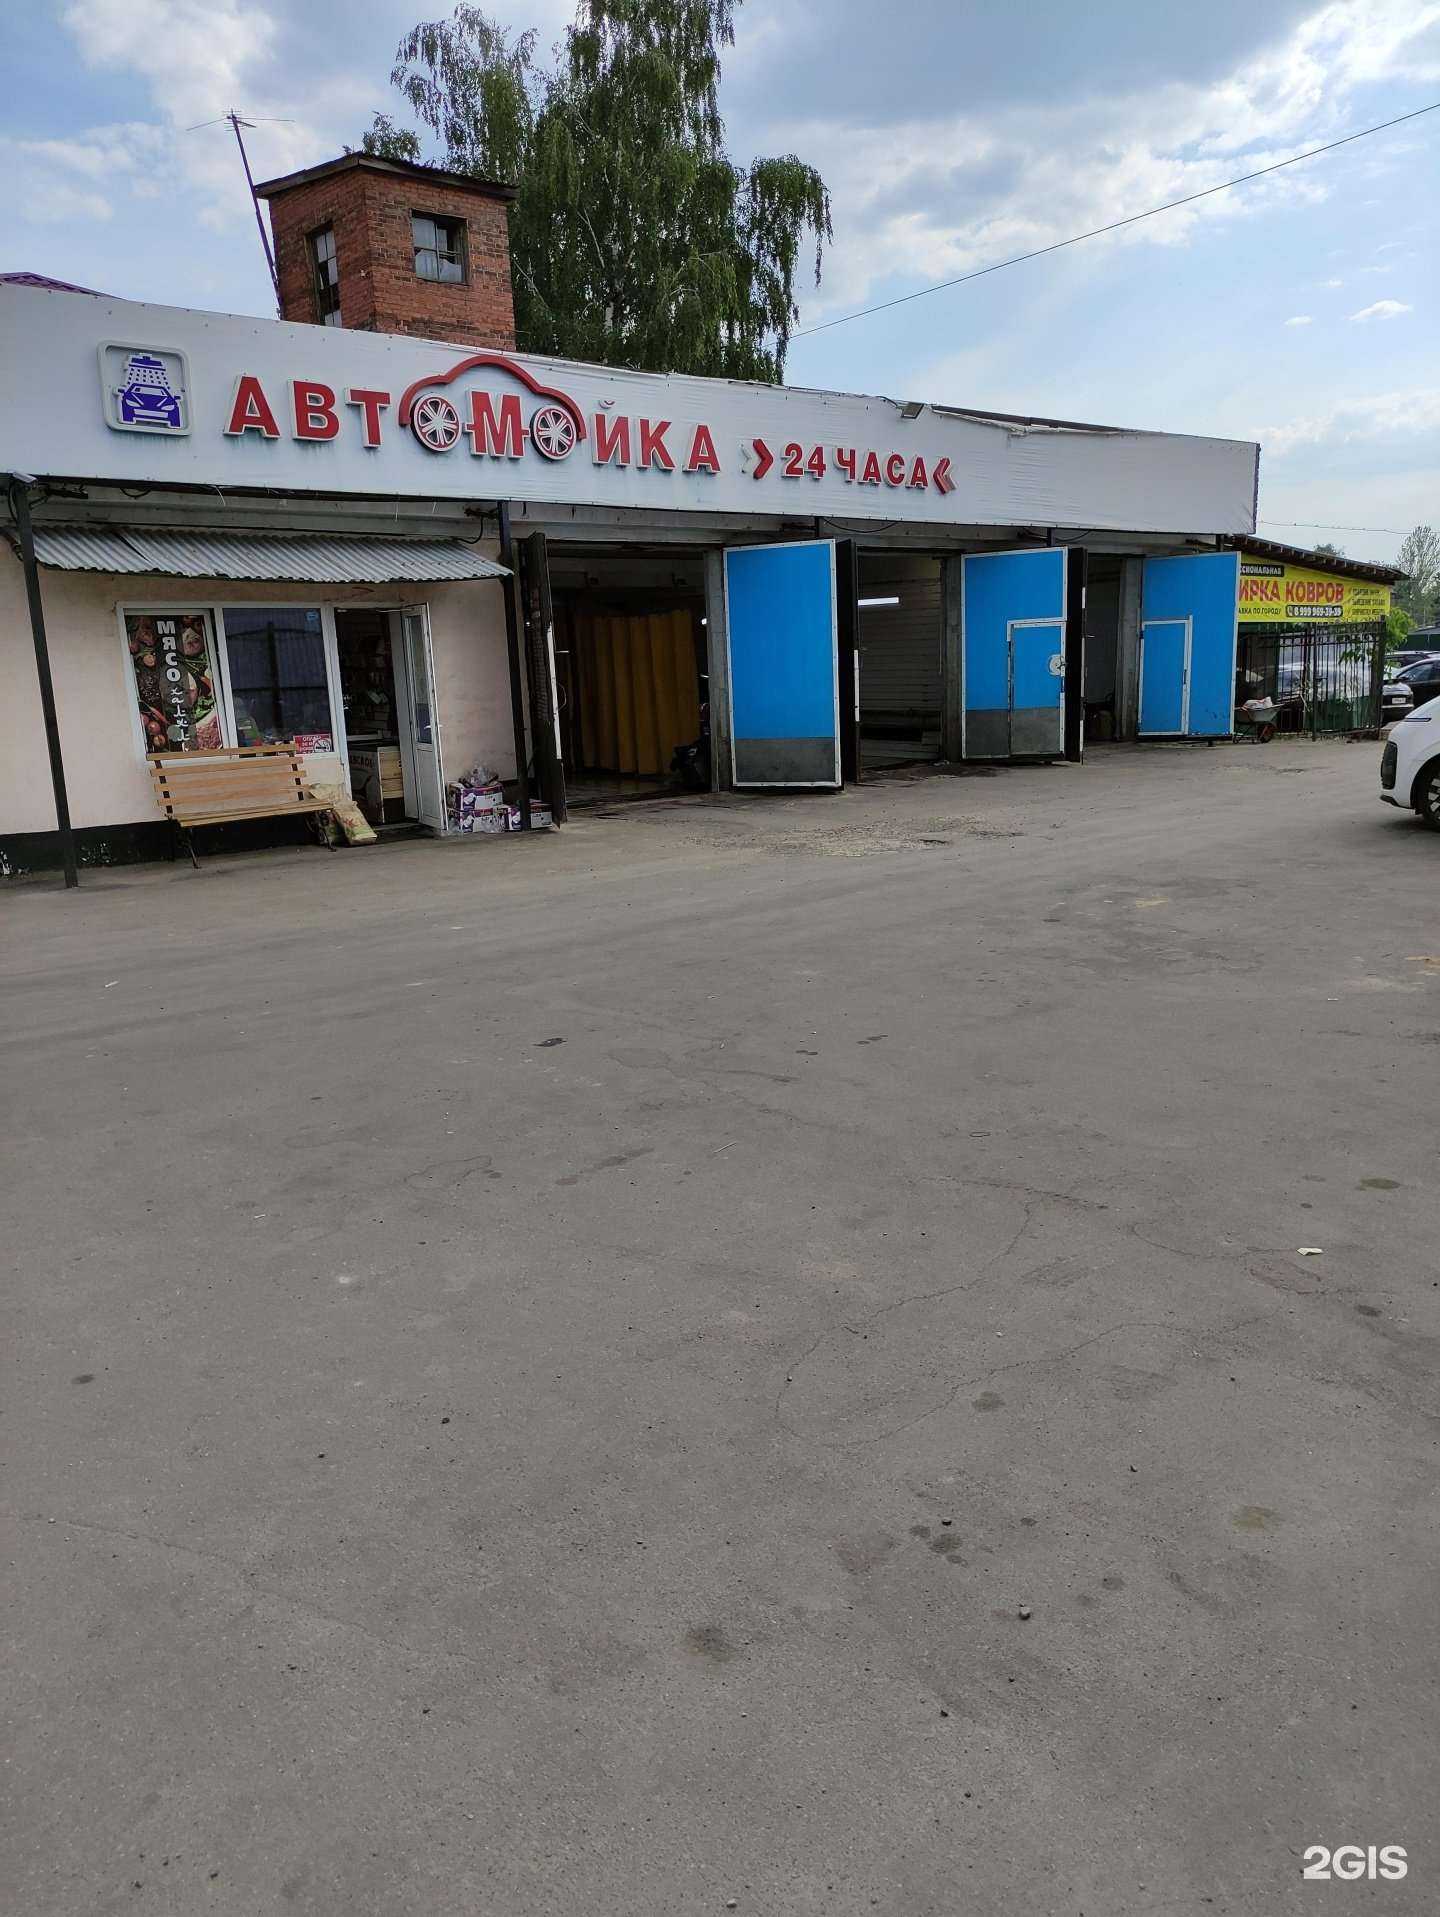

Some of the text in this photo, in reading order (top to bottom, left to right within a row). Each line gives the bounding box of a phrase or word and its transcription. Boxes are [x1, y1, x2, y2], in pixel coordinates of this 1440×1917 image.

[222, 372, 723, 474] АВТОМОЙКА
[782, 442, 929, 489] 24 ЧАСА
[1285, 580, 1345, 603] КОВРОВ
[1252, 607, 1261, 615] ПО
[1294, 606, 1299, 616] 8
[156, 620, 181, 682] МЯСО
